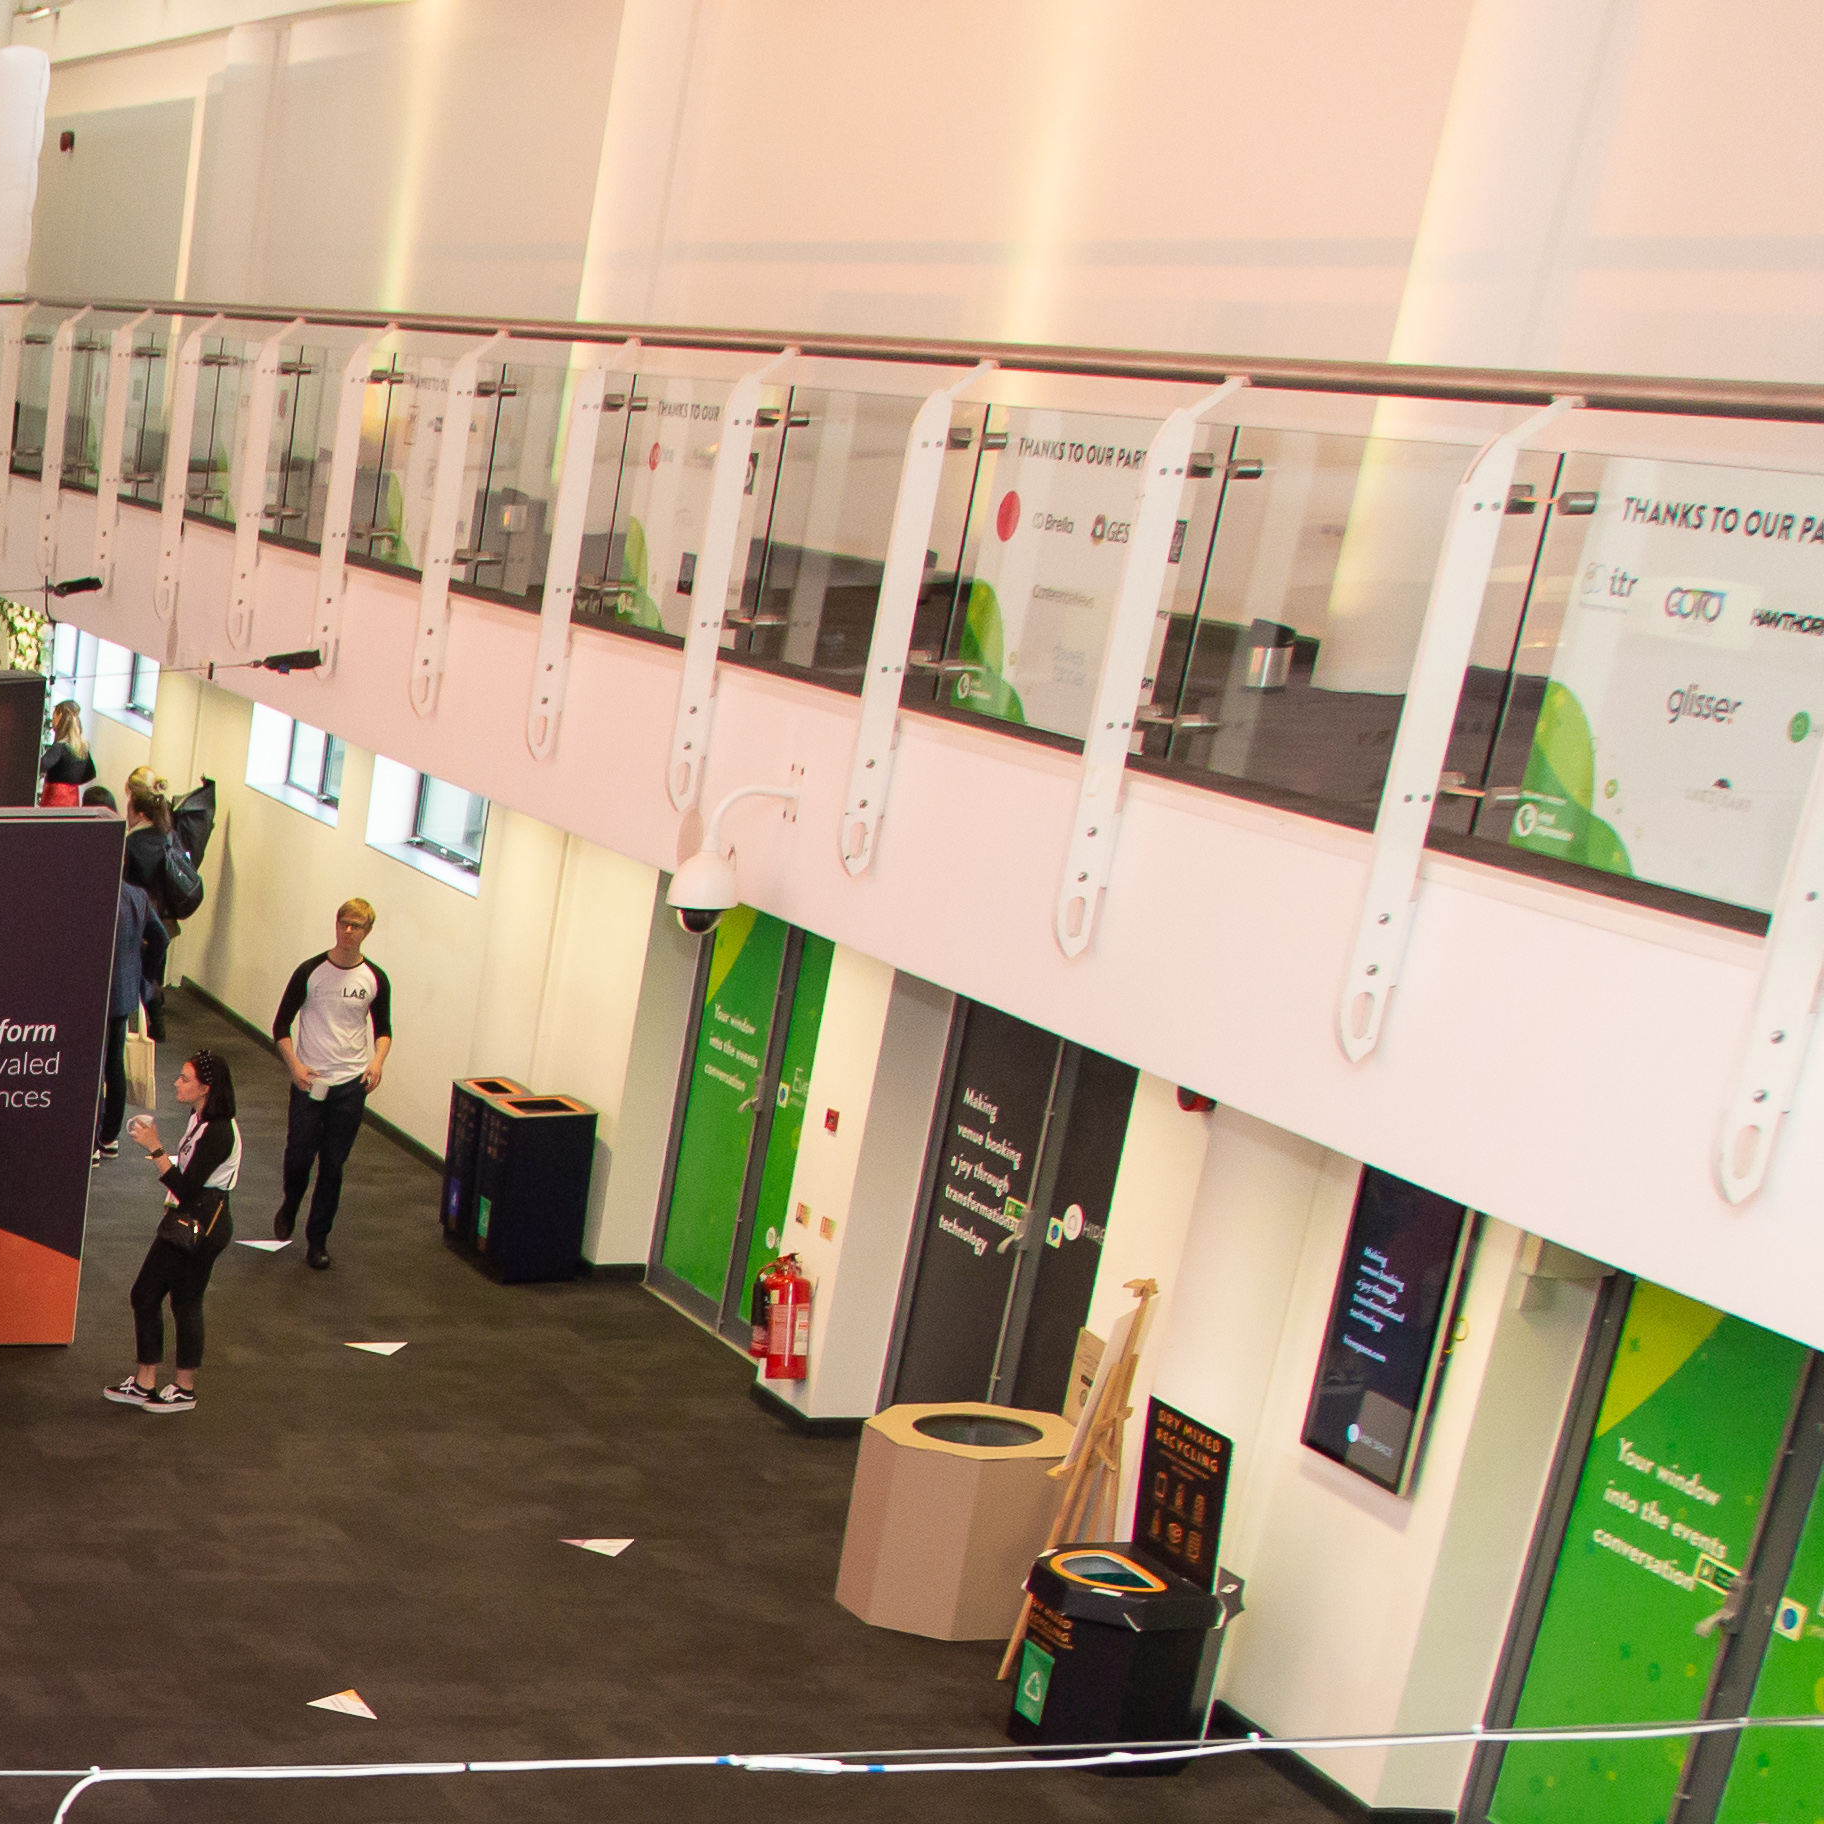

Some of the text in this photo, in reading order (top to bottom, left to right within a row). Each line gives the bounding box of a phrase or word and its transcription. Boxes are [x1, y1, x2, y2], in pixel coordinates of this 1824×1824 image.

[1018, 437, 1115, 468] THANKS TO OUR
[1106, 521, 1131, 543] GES
[1622, 496, 1797, 541] THANKS TO OUR
[1608, 567, 1640, 598] itr
[1666, 683, 1744, 724] glisser
[962, 1086, 1000, 1124] Making
[957, 1123, 1023, 1171] venue booking
[973, 1161, 1011, 1198] through
[938, 1213, 989, 1257] technology
[1155, 1426, 1219, 1474] RECYCLING
[1182, 1422, 1223, 1454] MIXED
[1617, 1436, 1722, 1507] Your window
[1602, 1479, 1729, 1560] into the events
[1592, 1527, 1697, 1593] conversation
